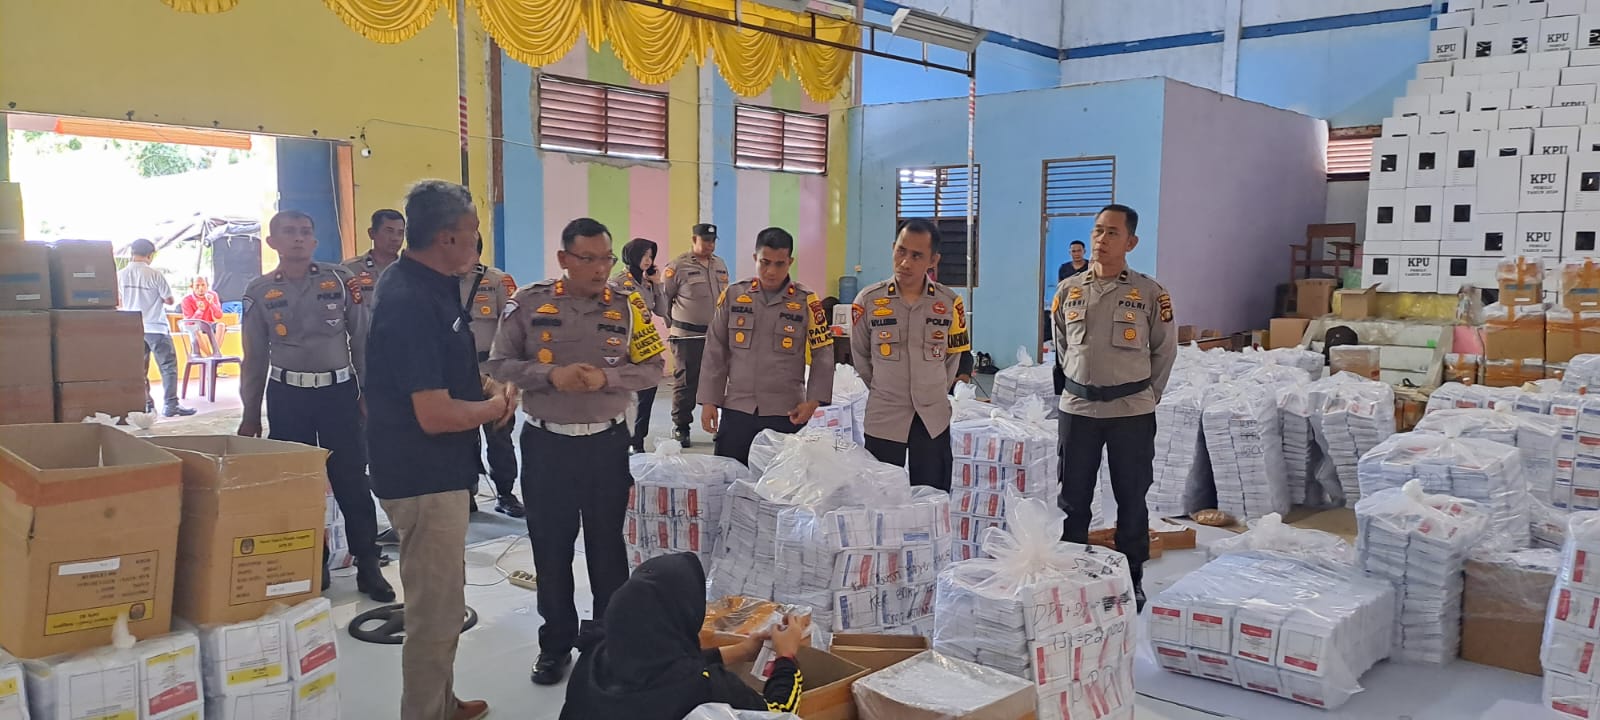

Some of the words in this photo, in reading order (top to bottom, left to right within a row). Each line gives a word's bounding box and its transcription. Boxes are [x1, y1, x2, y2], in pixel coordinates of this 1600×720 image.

[1547, 32, 1570, 43] KPU
[1436, 43, 1457, 53] KPU
[1530, 173, 1557, 184] KPU
[1525, 231, 1552, 242] KPU
[1407, 257, 1430, 267] KPU
[1117, 300, 1146, 310] POLRI
[779, 312, 804, 322] POLRI
